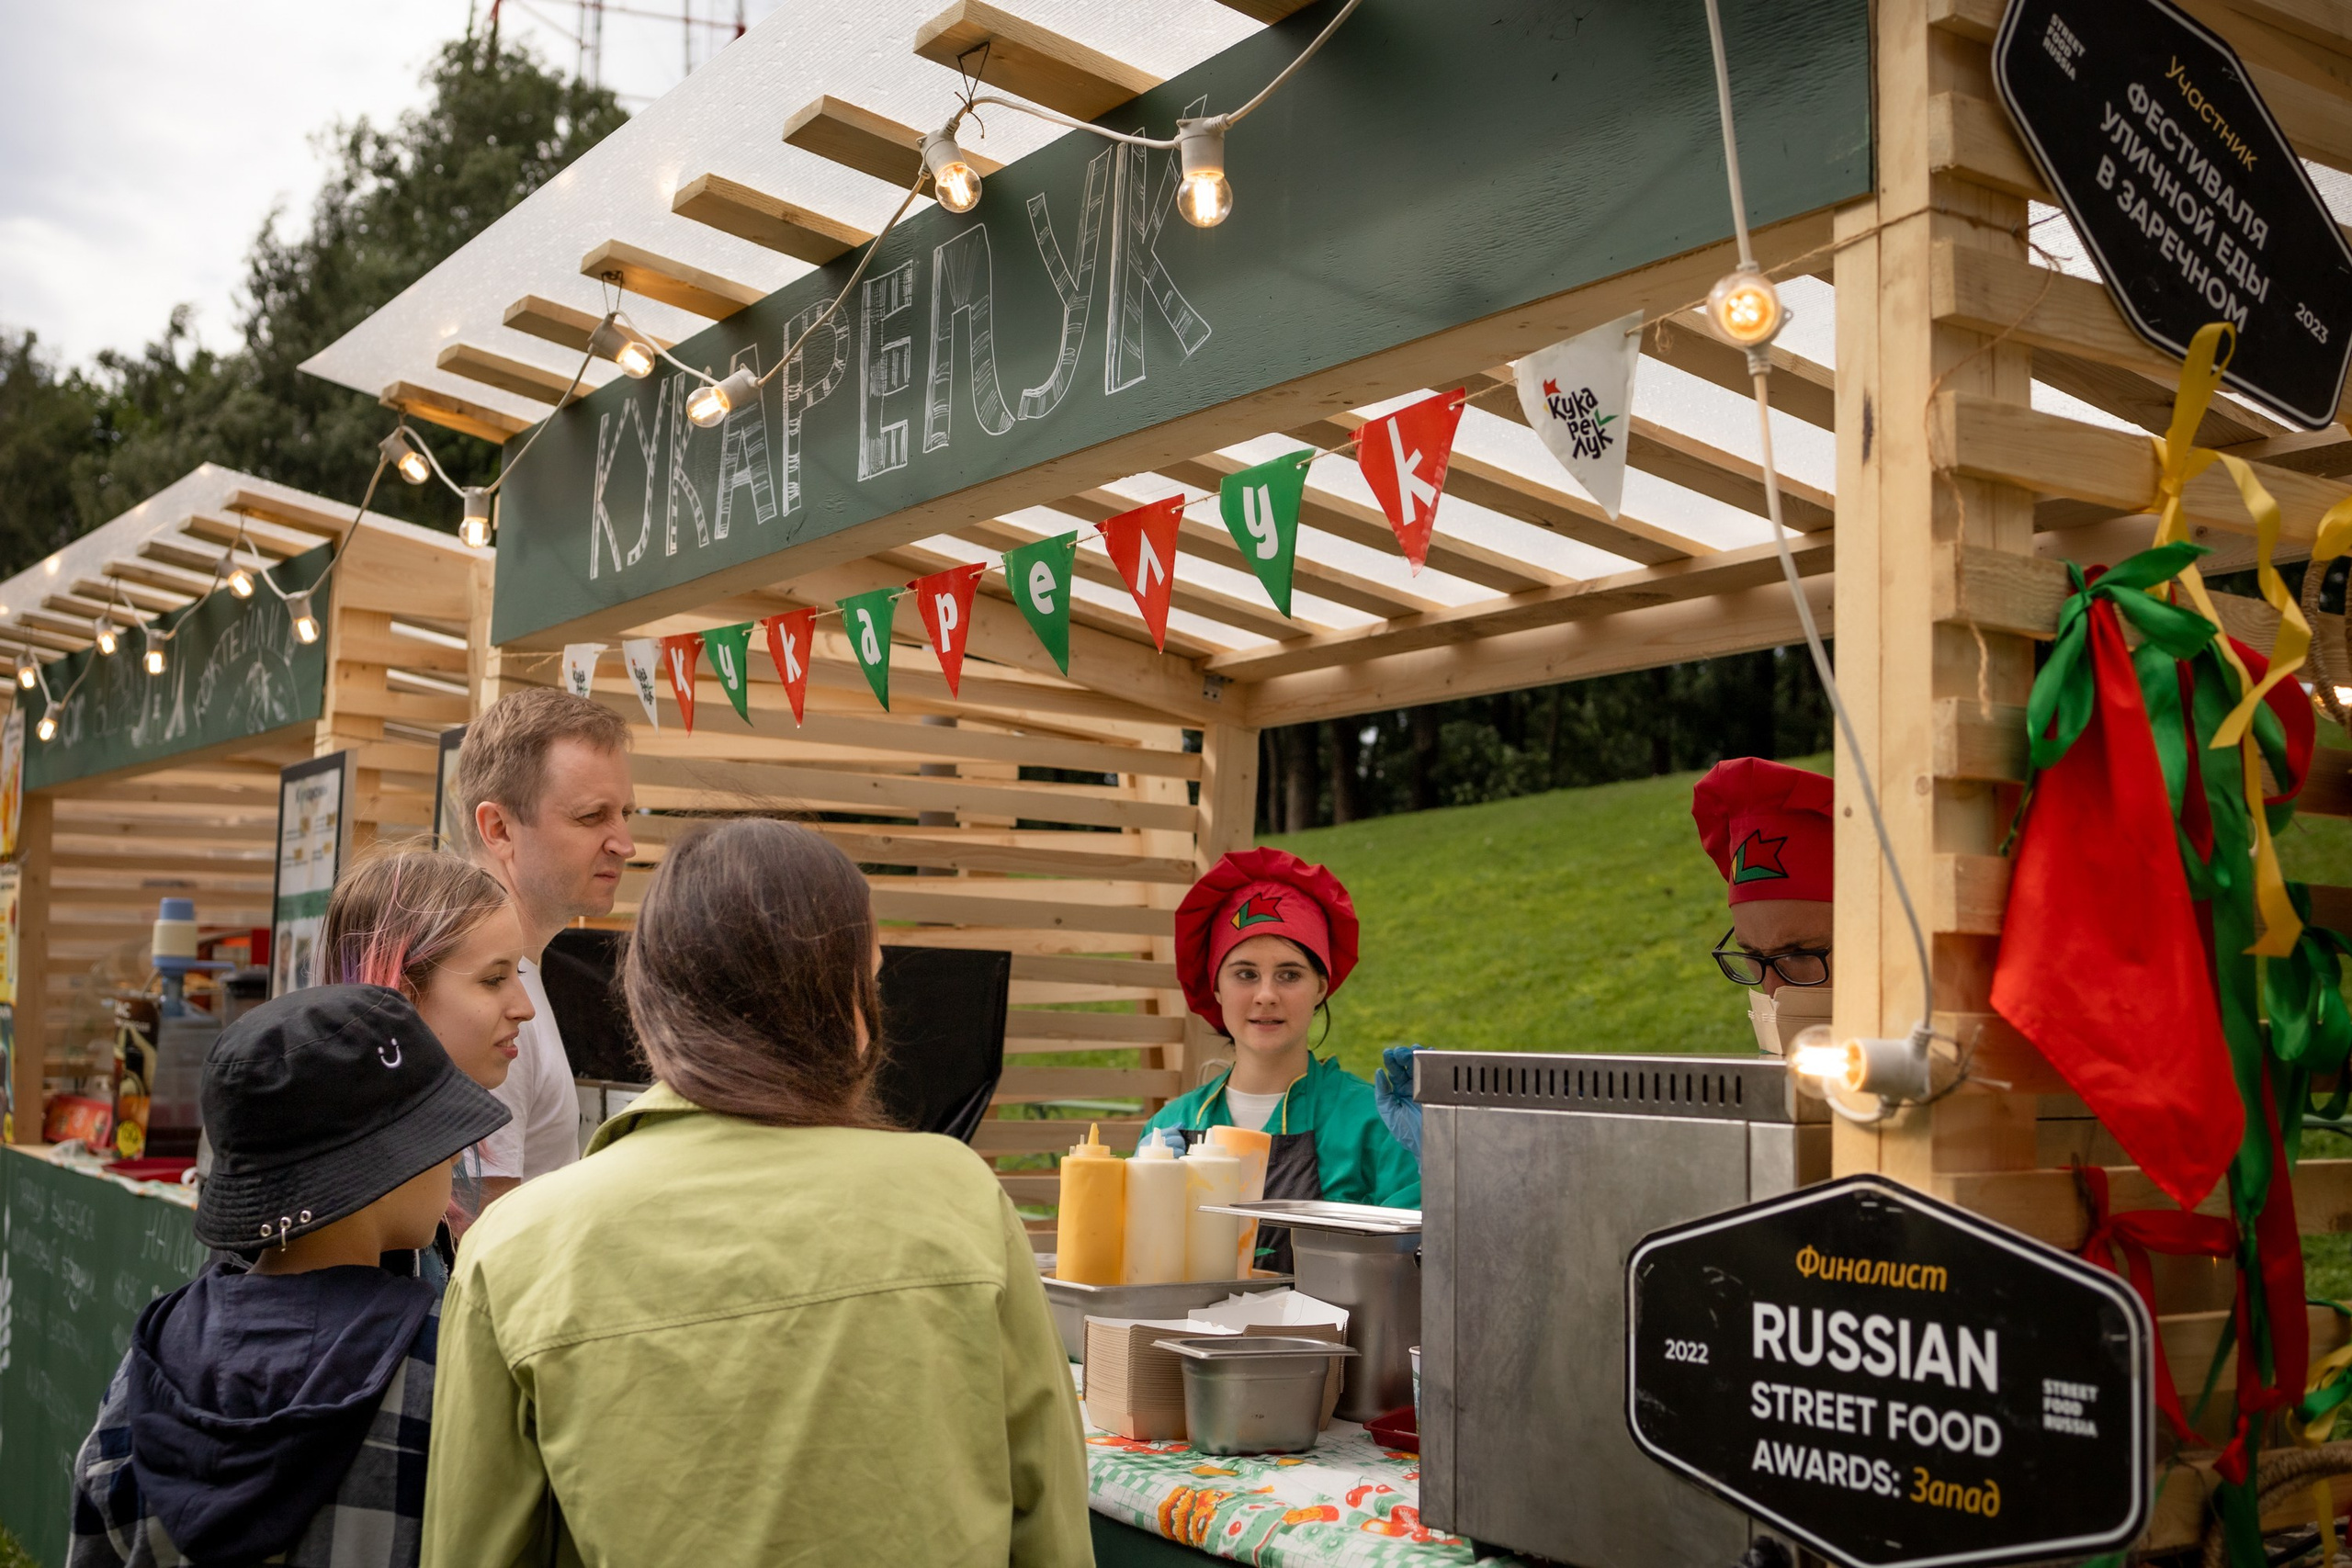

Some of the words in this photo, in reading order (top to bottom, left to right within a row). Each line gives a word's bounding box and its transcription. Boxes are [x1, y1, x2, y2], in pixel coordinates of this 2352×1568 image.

[2046, 25, 2072, 58] FOOD
[2050, 13, 2086, 57] STREET
[2041, 36, 2076, 81] RUSSIA
[2165, 56, 2257, 172] Участник
[2127, 82, 2269, 250] ФЕСТИВАЛЯ
[2100, 101, 2215, 246] УЛИЧНОЙ
[2215, 231, 2269, 303] ЕДЫ
[2096, 154, 2117, 190] В
[2117, 180, 2248, 333] ЗАРЕЧНОМ
[2295, 302, 2329, 344] 2023
[1795, 1245, 1948, 1292] Финалист
[1664, 1338, 1709, 1365] 2022
[1753, 1301, 1999, 1393] RUSSIAN
[2042, 1378, 2099, 1403] STREET
[2042, 1396, 2083, 1416] FOOD
[1751, 1381, 1878, 1436] STREET
[1888, 1402, 2002, 1457] FOOD
[2042, 1413, 2098, 1438] RUSSIA
[1751, 1438, 1902, 1498] AWARDS:
[1909, 1467, 2001, 1517] Запад
